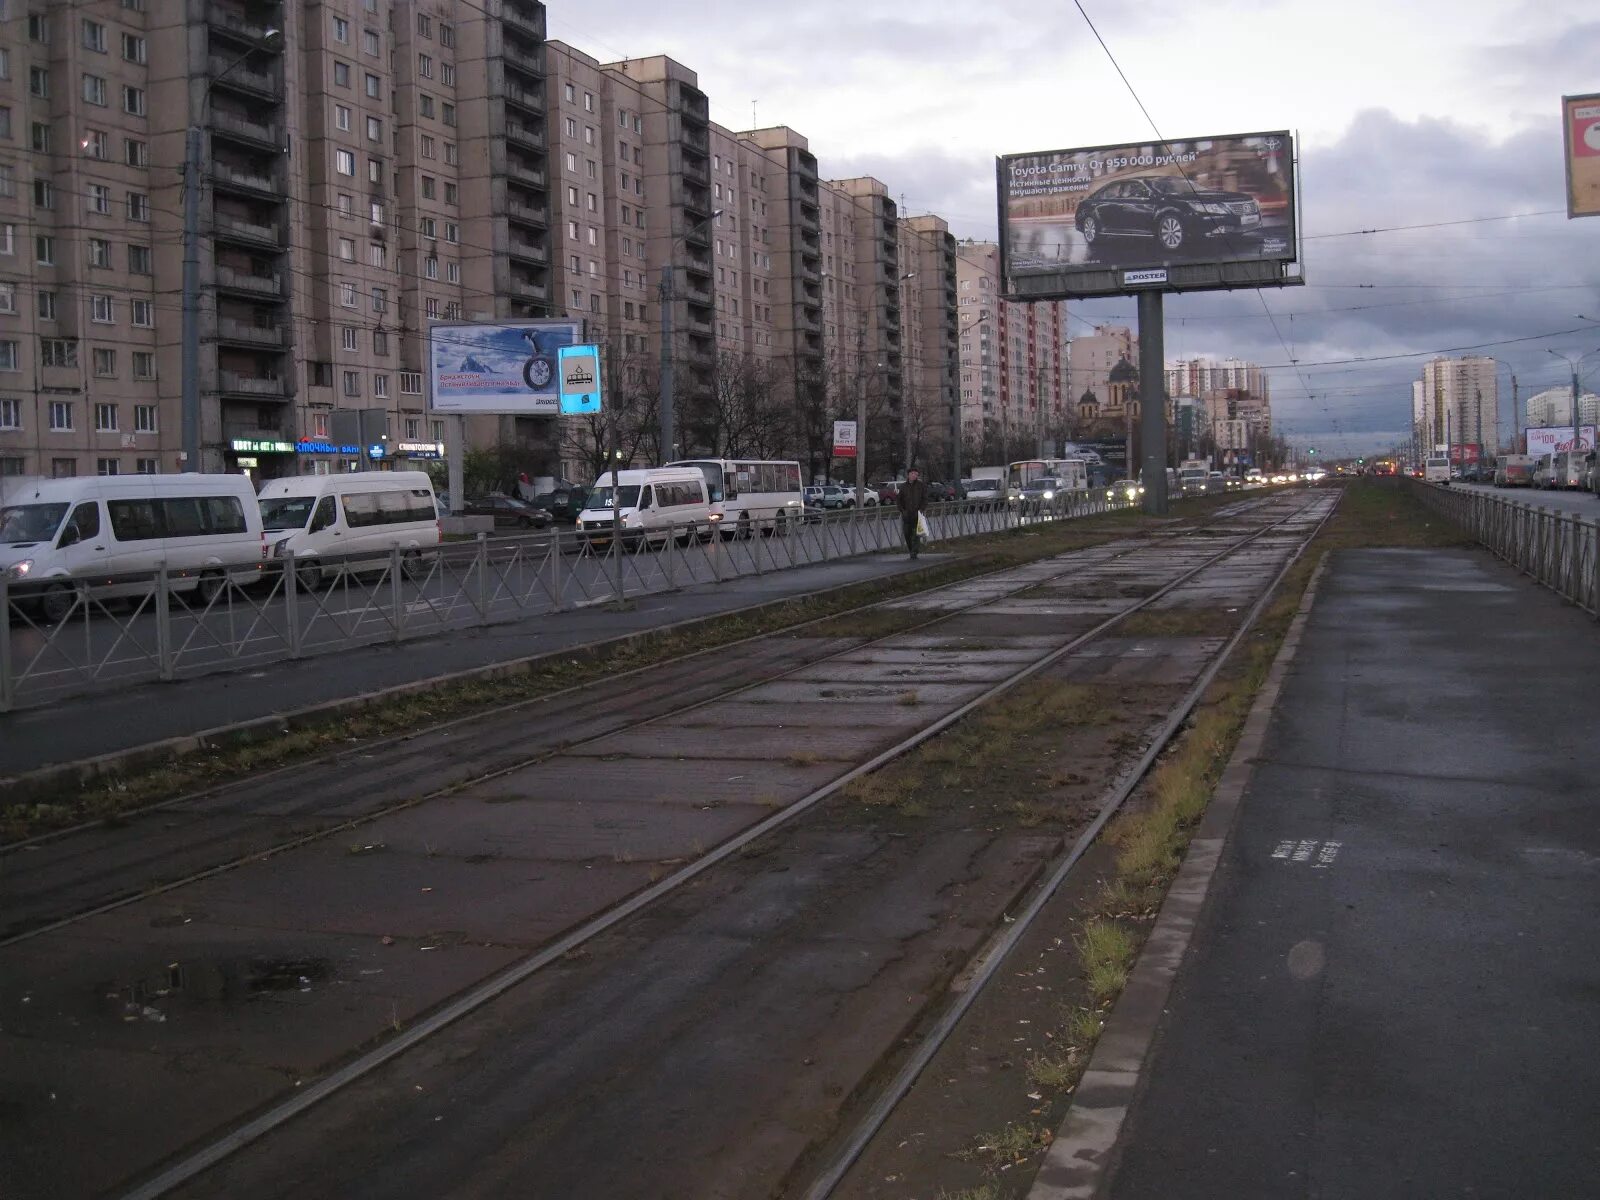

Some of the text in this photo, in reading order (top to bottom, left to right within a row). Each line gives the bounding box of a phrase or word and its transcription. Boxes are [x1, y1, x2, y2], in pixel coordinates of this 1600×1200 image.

[1009, 165, 1047, 178] Toyota
[1089, 160, 1104, 170] От
[1106, 157, 1128, 168] 959
[1129, 156, 1153, 166] 000
[1009, 176, 1092, 187] Истинные ценности
[1009, 184, 1089, 196] внушают уважение
[1132, 272, 1166, 281] POSTER
[1541, 434, 1555, 444] 100
[296, 442, 338, 453] СТОЧНЫЙ
[604, 498, 615, 506] 15
